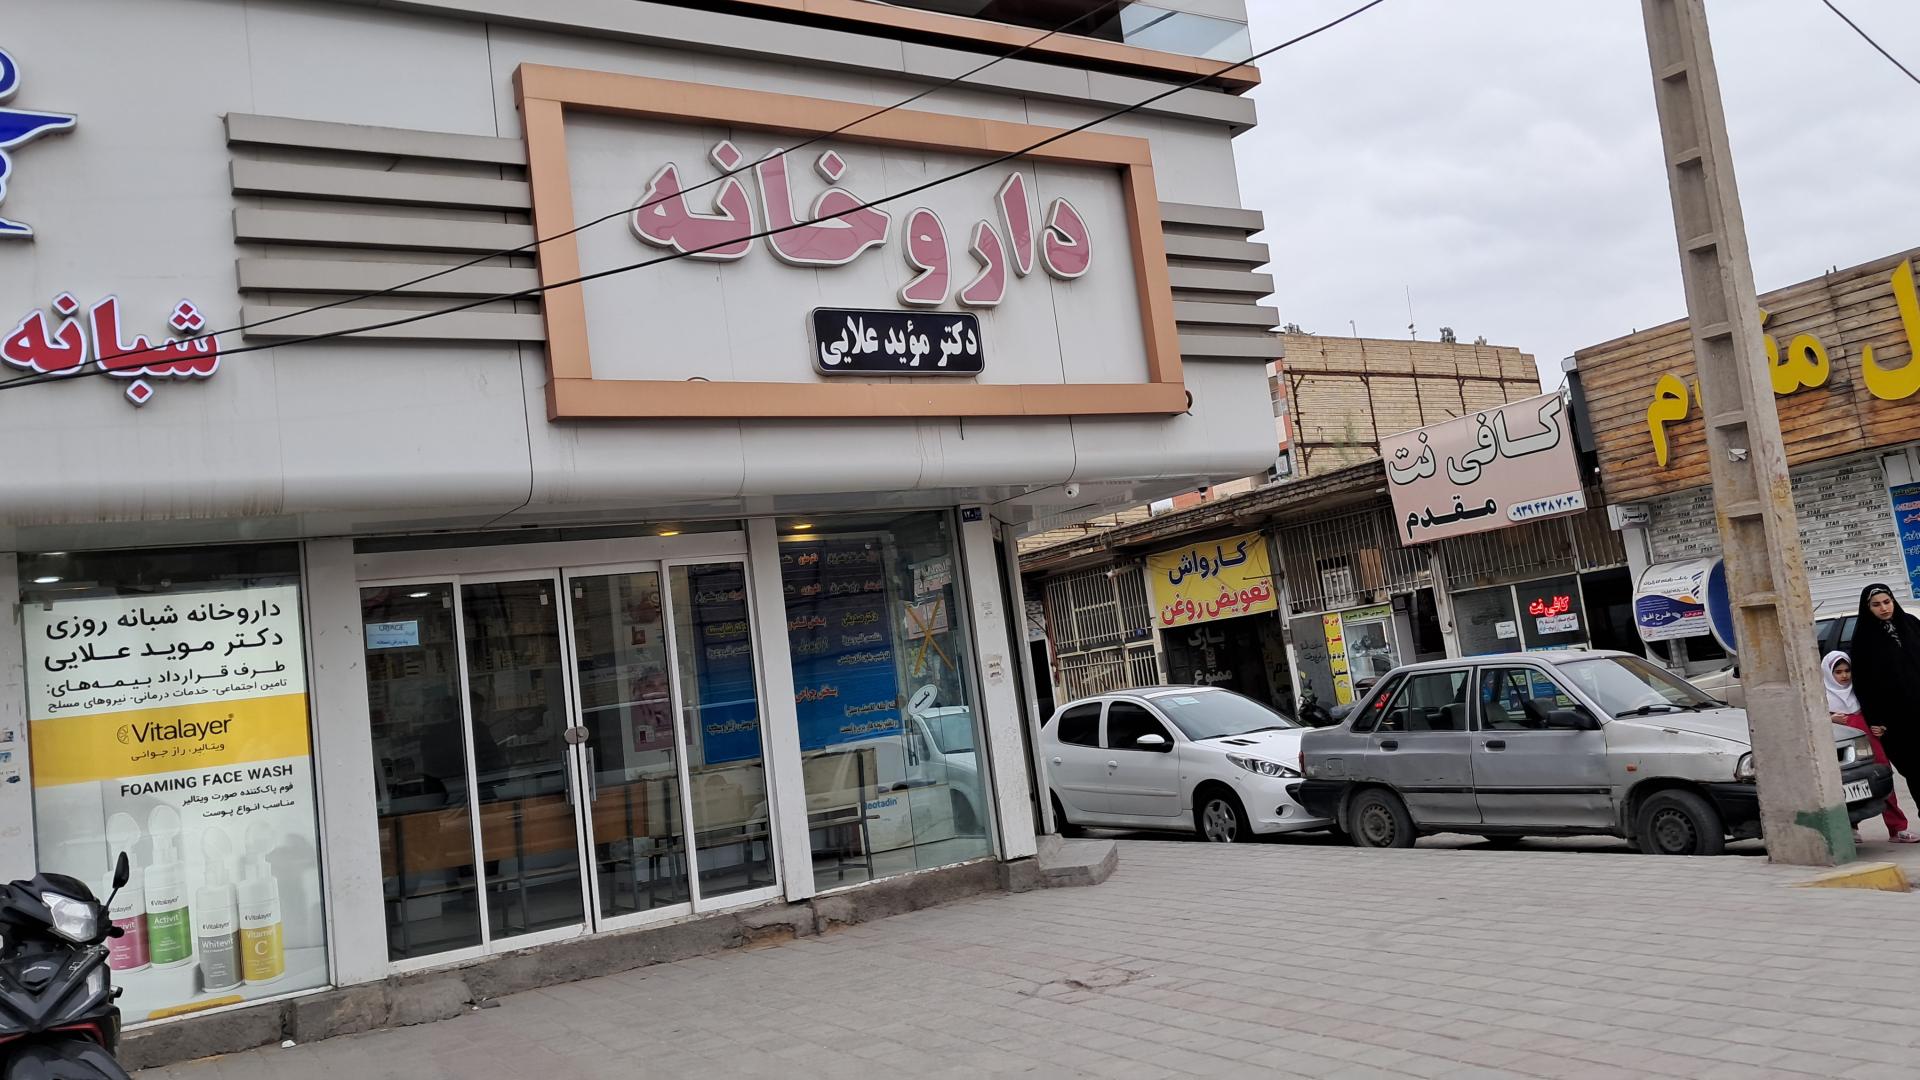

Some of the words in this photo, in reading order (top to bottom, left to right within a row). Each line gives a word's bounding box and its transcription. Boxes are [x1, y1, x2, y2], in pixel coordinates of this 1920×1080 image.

[629, 139, 1093, 308] داروخانه
[0, 291, 221, 408] شبانه
[820, 316, 879, 366] علایی
[939, 321, 978, 366] دکتر
[1447, 396, 1561, 485] کافی
[1389, 432, 1436, 485] نت
[1406, 495, 1497, 539] مقدم
[1168, 540, 1247, 585] کارواش
[1206, 579, 1271, 617] تعویض
[1529, 599, 1544, 615] نت
[1545, 596, 1569, 617] کافی
[117, 605, 179, 631] شبانه
[186, 600, 281, 625] داروخانه
[1161, 593, 1203, 625] روغن
[46, 616, 108, 640] روزی
[1188, 627, 1225, 650] پارک
[140, 640, 215, 660] موید
[224, 627, 283, 656] دکتر
[44, 643, 131, 672] علایی
[158, 665, 229, 685] قرارداد
[233, 661, 286, 679] طرف
[172, 685, 209, 697] خدمات
[260, 678, 287, 692] تامین
[47, 700, 80, 713] مسلح
[83, 693, 127, 710] نیروهای
[172, 745, 186, 756] راز
[120, 777, 197, 797] FOAMING
[203, 770, 243, 787] FACE
[247, 764, 294, 781] WASH
[279, 783, 294, 795] فوم
[212, 792, 238, 802] صورت
[262, 799, 295, 811] مناسب
[202, 807, 234, 819] پوست
[236, 803, 260, 815] انواع
[154, 914, 180, 924] Activit
[202, 937, 234, 949] Whitevit
[255, 940, 268, 956] C
